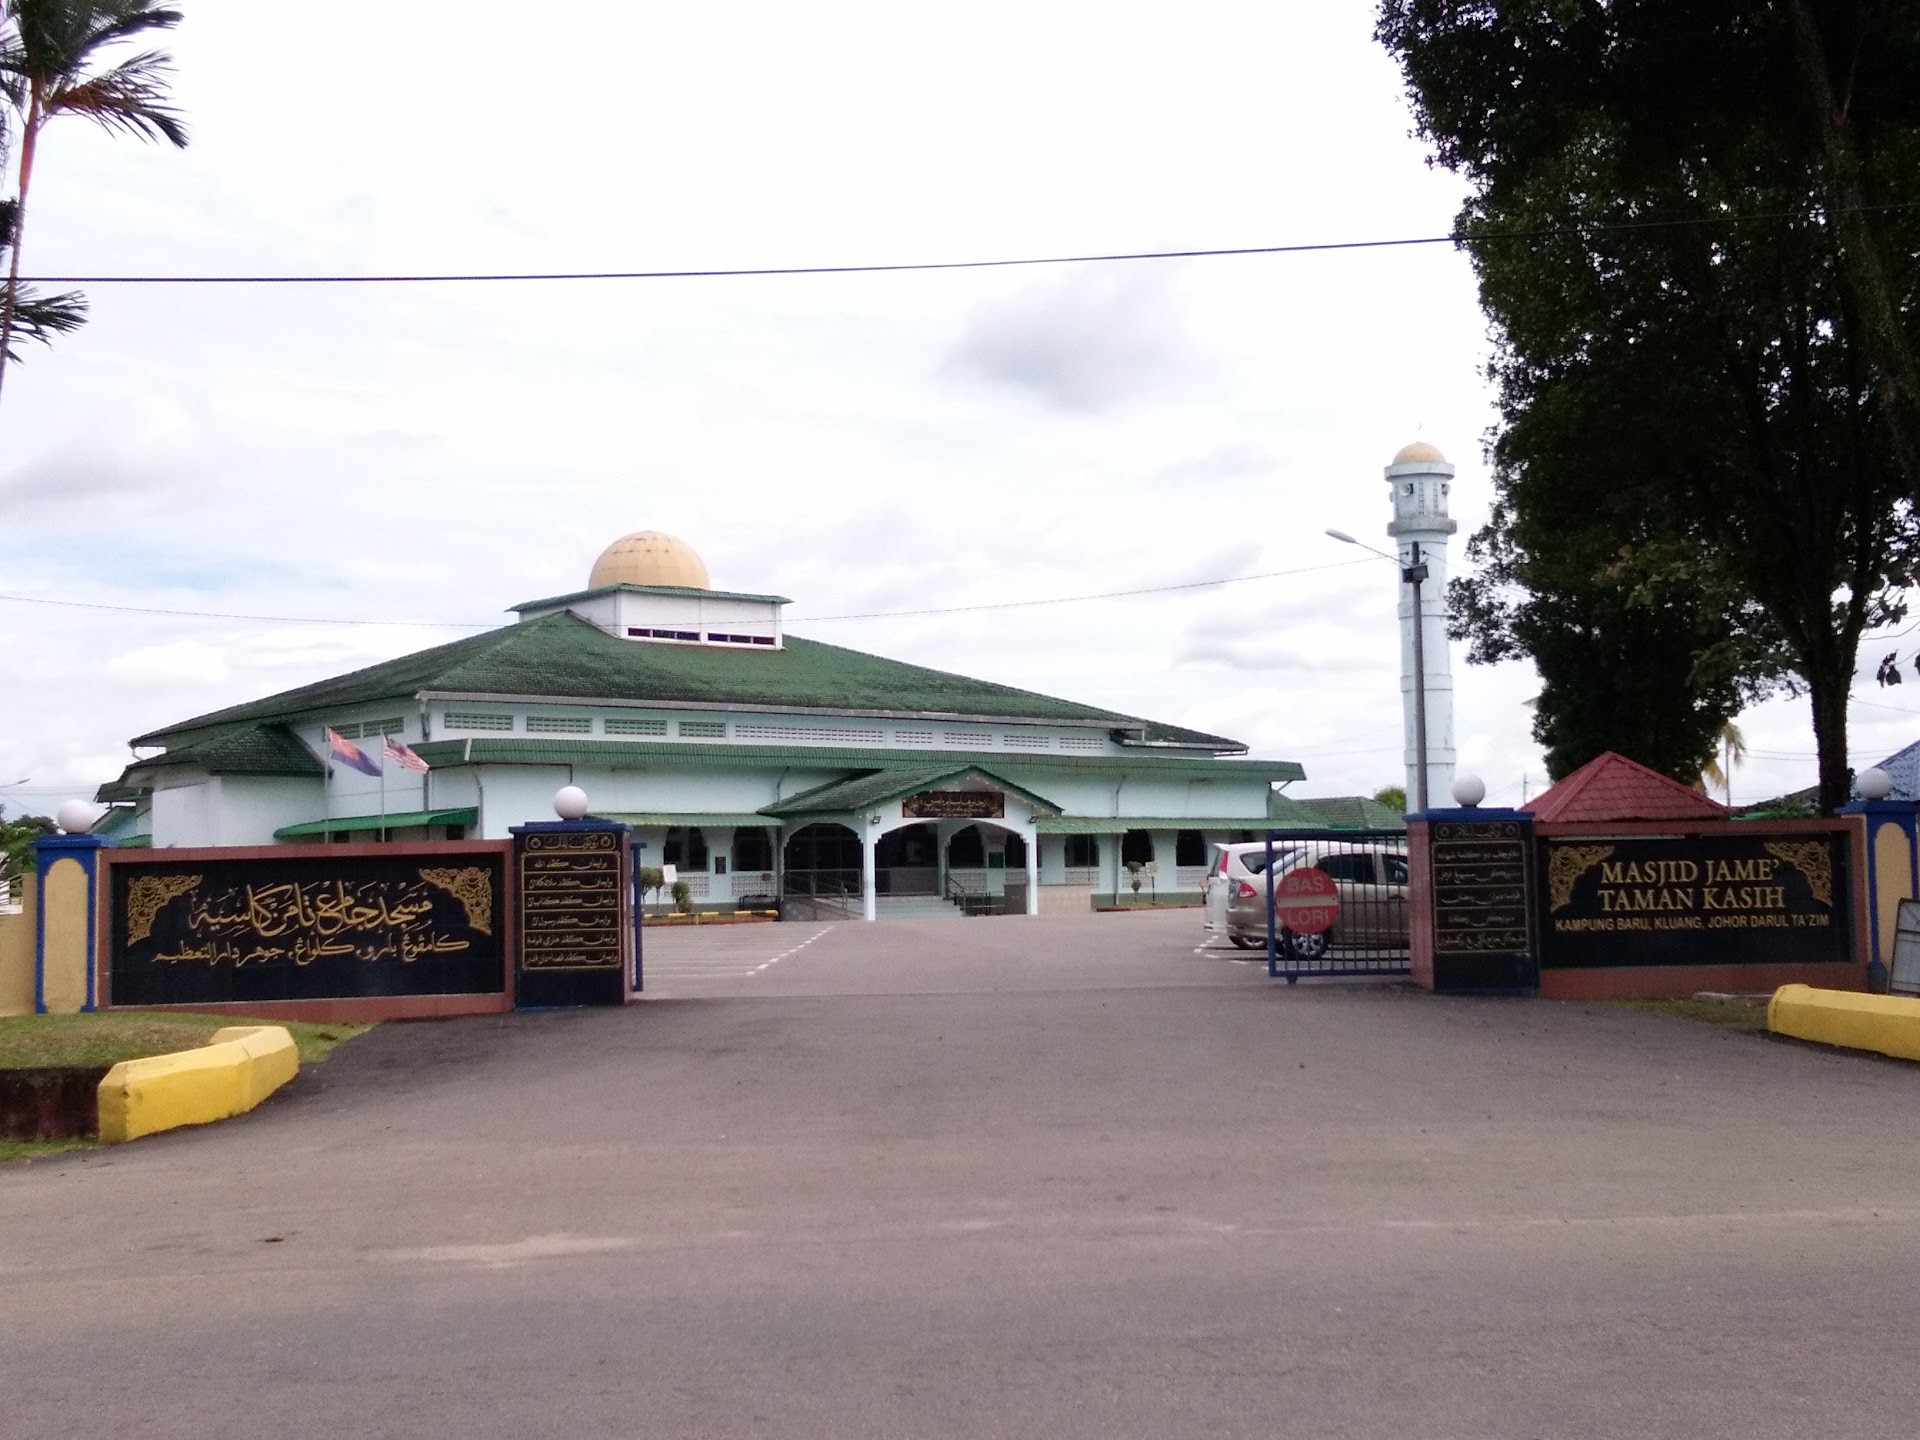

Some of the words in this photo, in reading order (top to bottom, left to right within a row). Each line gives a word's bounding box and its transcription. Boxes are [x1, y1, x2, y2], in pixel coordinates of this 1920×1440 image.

[1600, 860, 1698, 886] MASJID
[1287, 877, 1324, 892] BAS
[1597, 888, 1695, 912] TAMAN
[1702, 886, 1786, 910] KASIH
[1287, 910, 1329, 925] LORI
[1555, 918, 1614, 932] KAMPUNG
[1616, 917, 1652, 931] BARU,
[1708, 915, 1748, 928] JOHOR
[1750, 914, 1789, 928] DARUL
